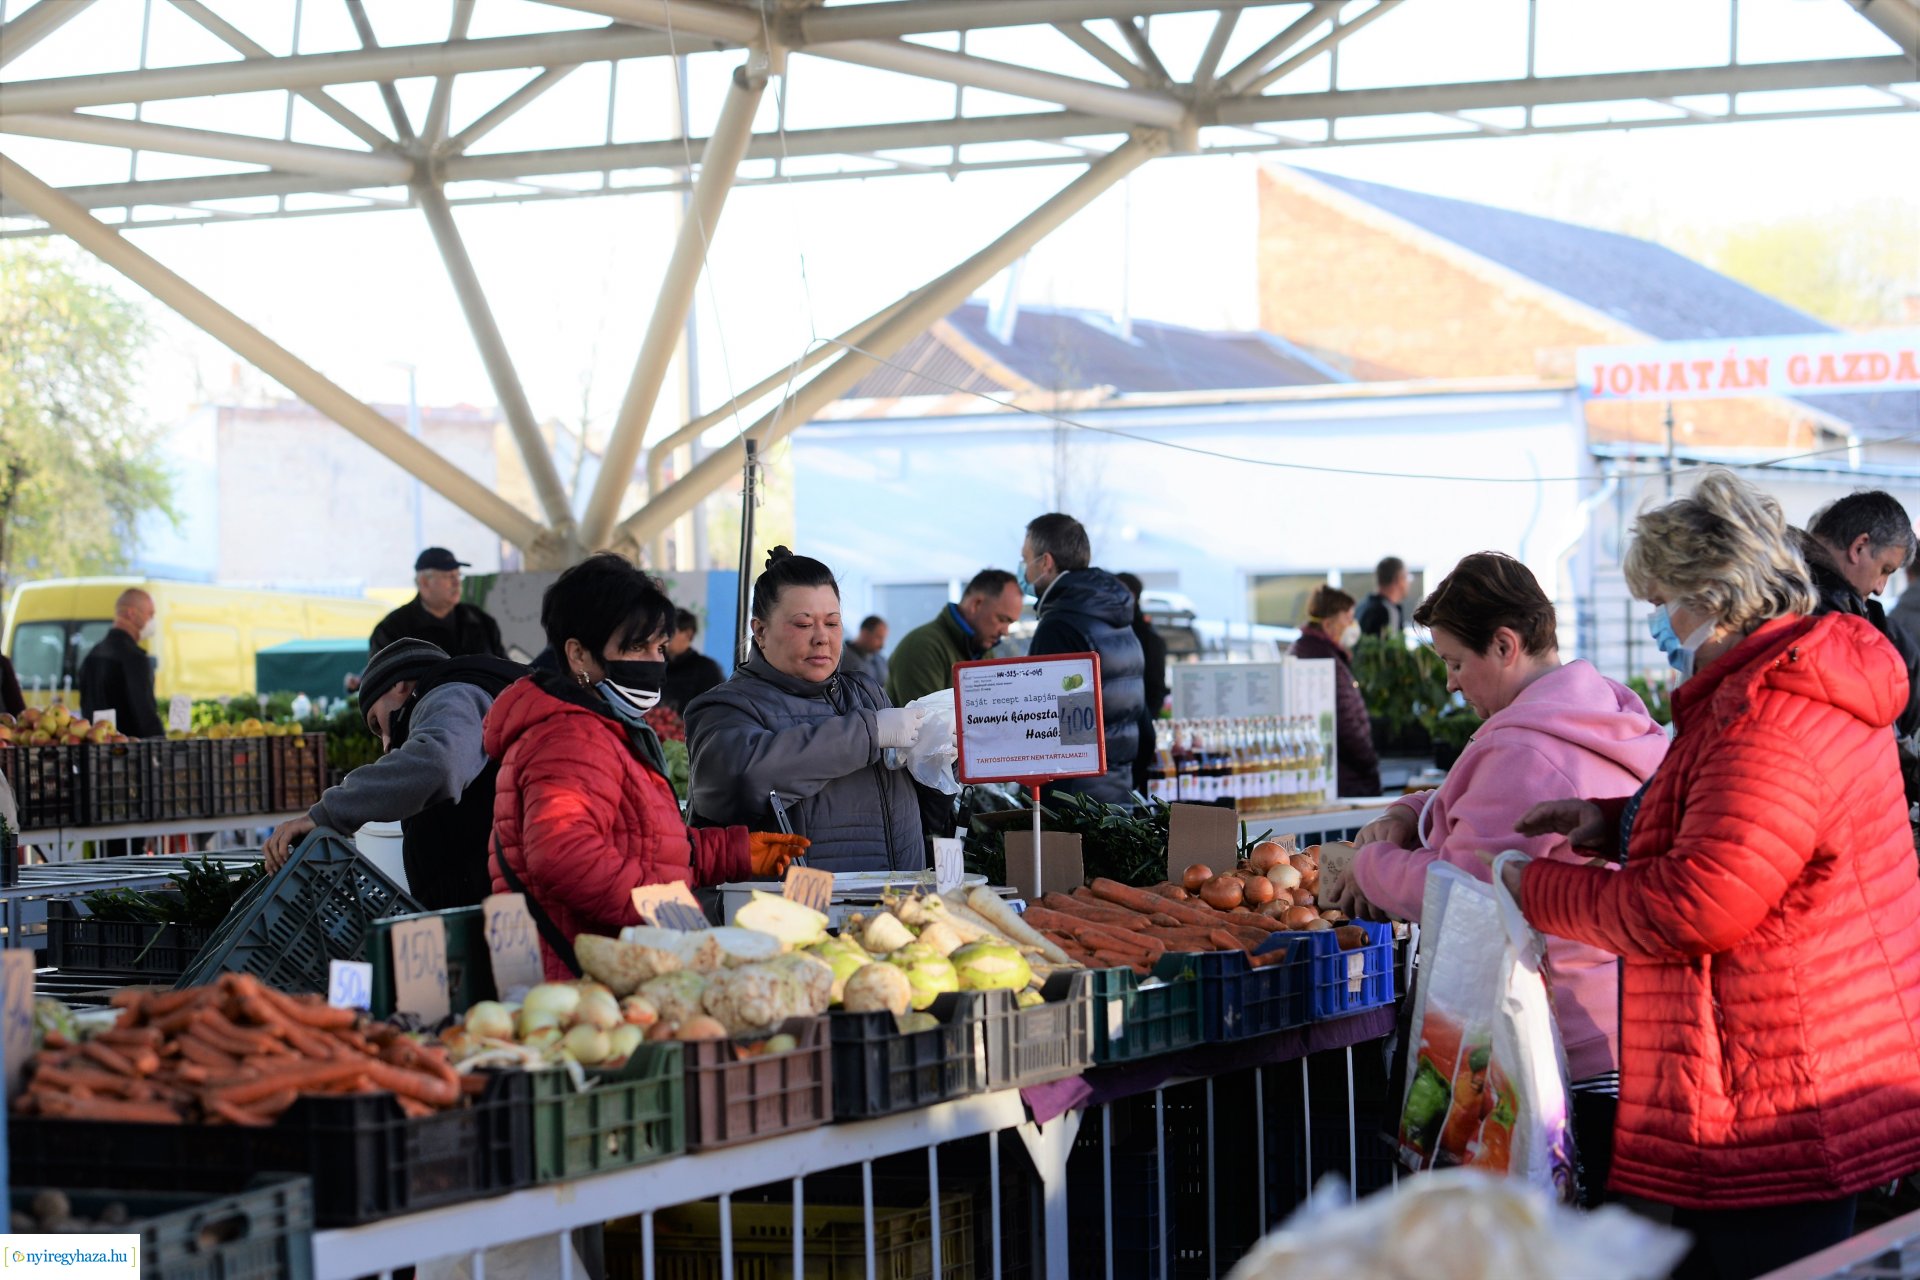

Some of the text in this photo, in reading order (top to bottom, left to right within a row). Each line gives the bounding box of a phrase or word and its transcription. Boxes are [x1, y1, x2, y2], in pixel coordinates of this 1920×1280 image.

[1592, 348, 1920, 394] JONATÁN GAZDA
[965, 693, 1057, 707] Saját recept alapján
[967, 711, 1008, 725] Savanyú
[1060, 706, 1094, 736] 400
